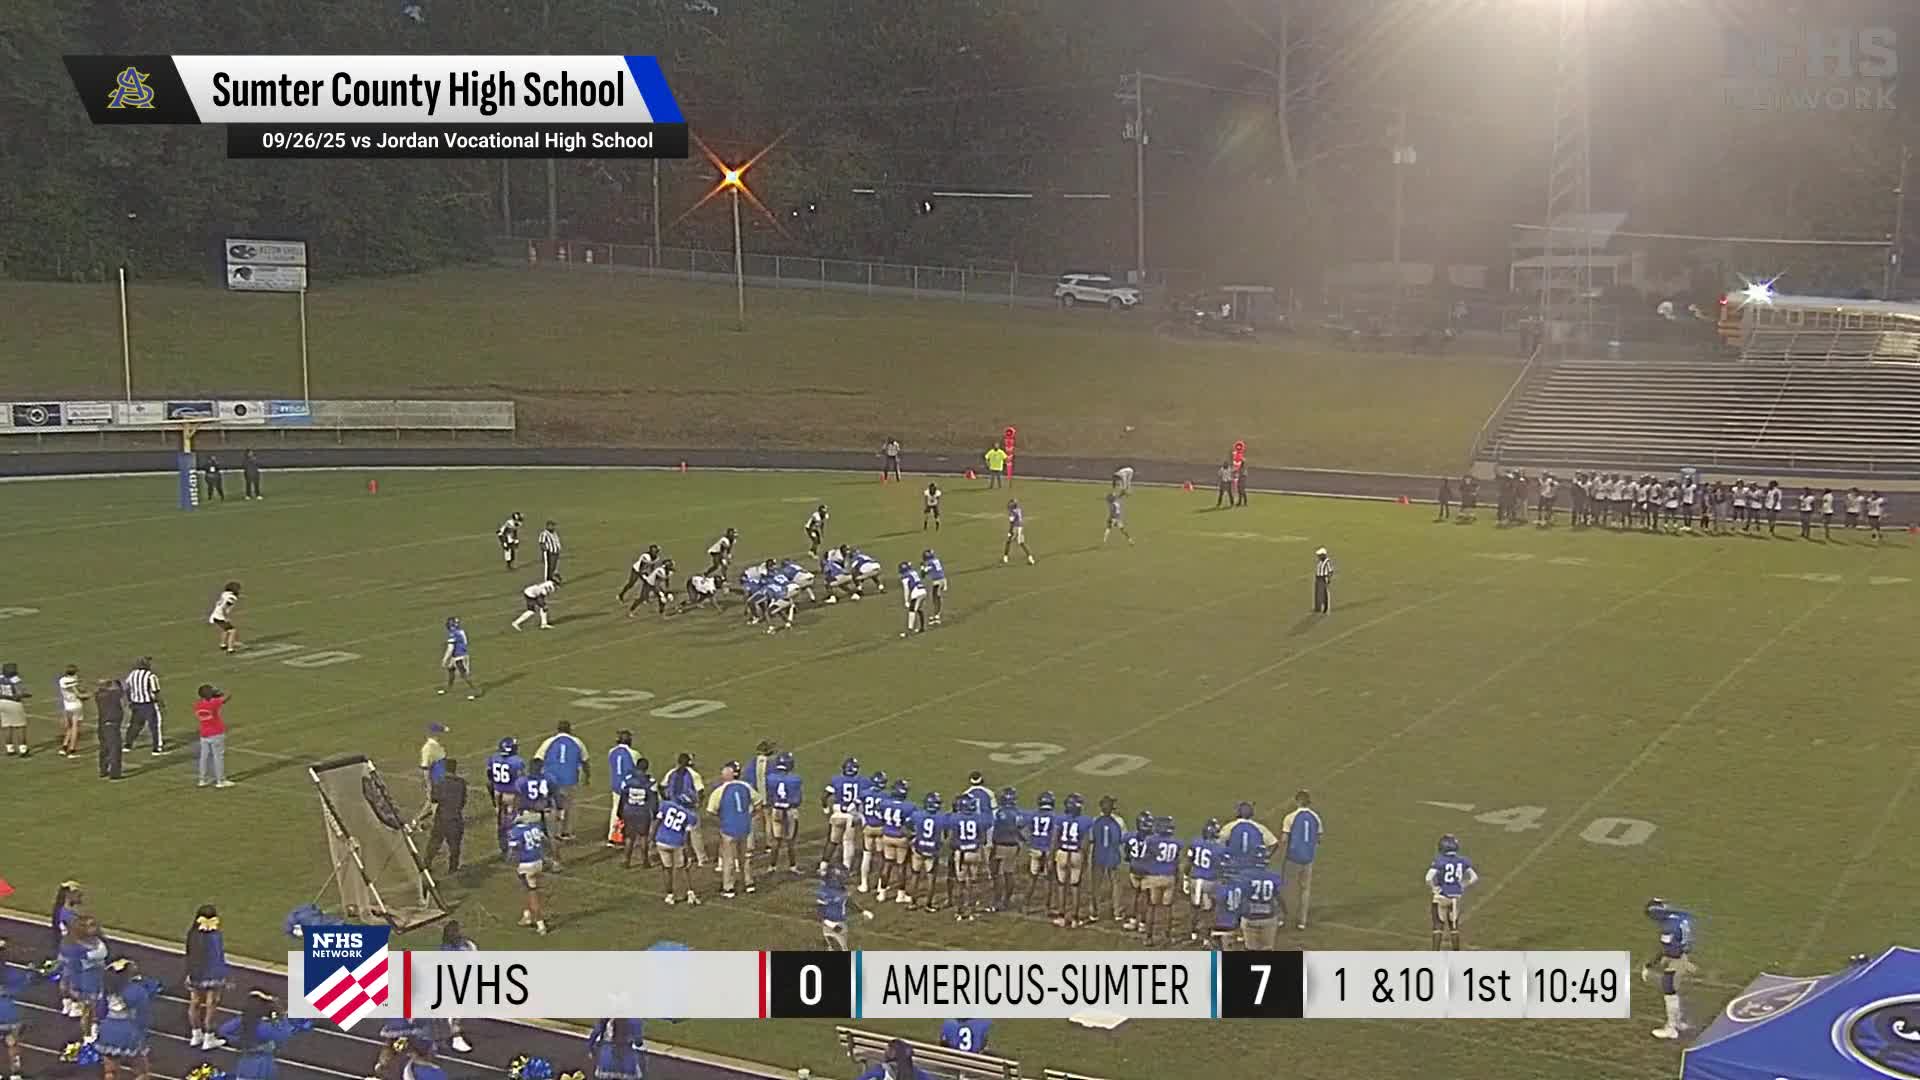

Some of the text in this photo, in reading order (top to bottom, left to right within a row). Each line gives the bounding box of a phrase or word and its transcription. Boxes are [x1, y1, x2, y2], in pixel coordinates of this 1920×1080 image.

[492, 763, 511, 783] 56
[527, 779, 549, 800] 54
[776, 782, 787, 799] 4
[843, 783, 859, 802] 51
[663, 807, 687, 832] 62
[884, 807, 902, 827] 44
[1033, 816, 1051, 837] 17
[923, 818, 935, 838] 9
[959, 820, 977, 840] 19
[1061, 821, 1079, 842] 14
[1128, 838, 1147, 858] 37
[1156, 842, 1177, 862] 30
[1193, 846, 1212, 868] 16
[1444, 863, 1463, 883] 24
[1251, 879, 1274, 901] 70
[958, 1026, 972, 1050] 3
